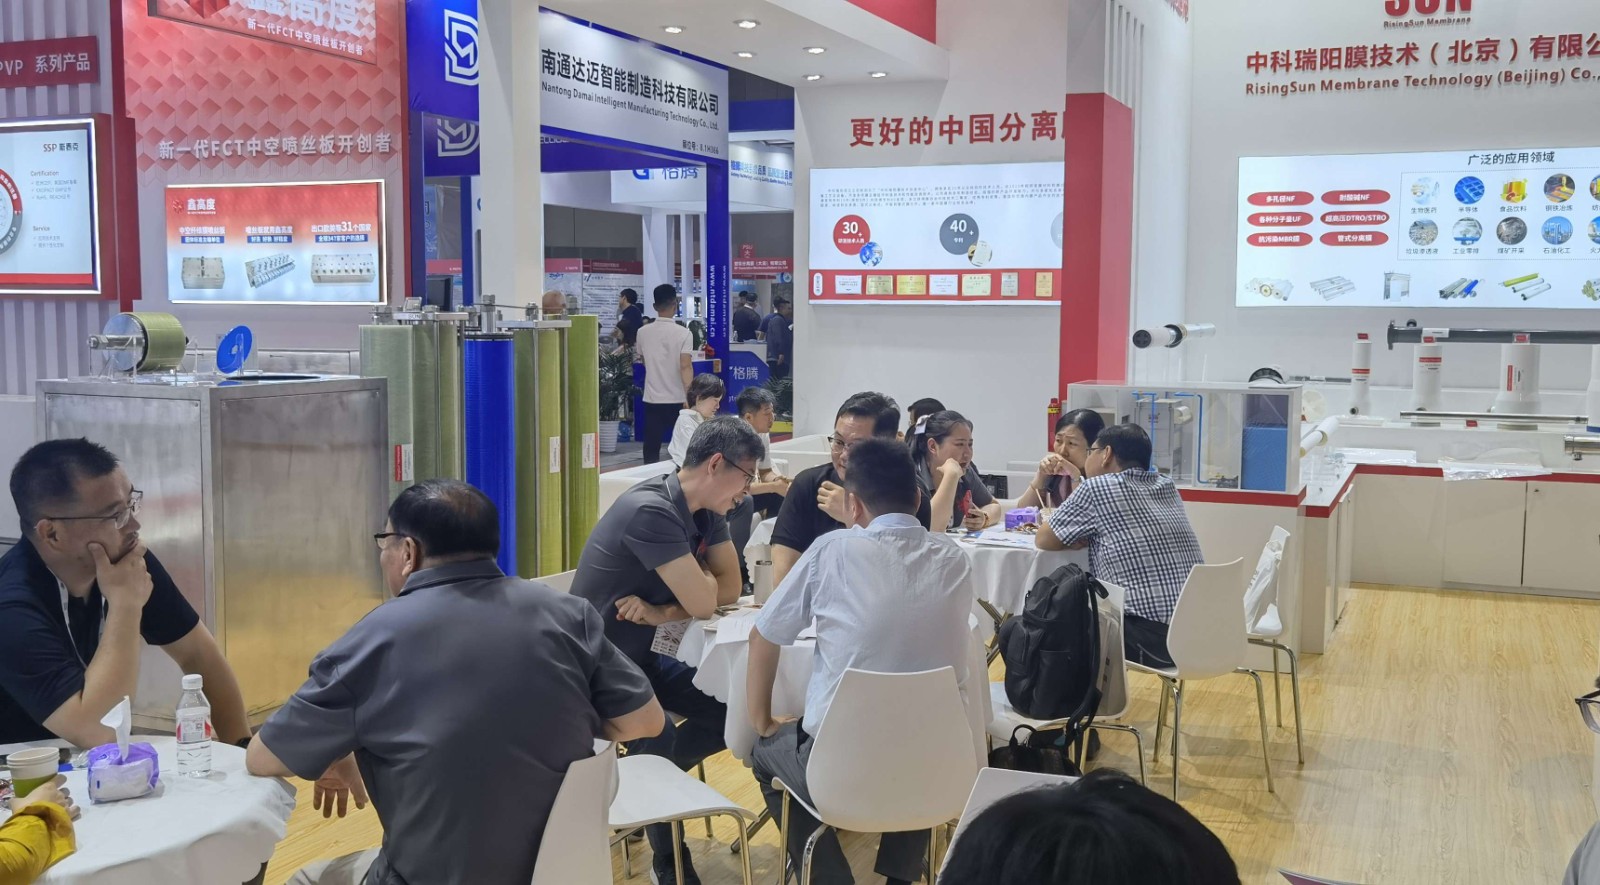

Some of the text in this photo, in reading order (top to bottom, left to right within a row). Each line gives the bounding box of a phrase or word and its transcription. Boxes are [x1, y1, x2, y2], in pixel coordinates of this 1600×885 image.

[1383, 17, 1471, 29] RisingSun Membrane
[35, 52, 91, 74] 系列产品
[541, 48, 719, 116] 南通达迈智能制造科技有限公司
[1245, 81, 1316, 97] RisingSun
[1320, 77, 1399, 92] Membrane
[1403, 73, 1493, 88] Technology
[1497, 68, 1566, 85] (Beijing)
[541, 81, 572, 100] Nantong
[573, 88, 594, 102] Damai
[594, 93, 627, 110] Intelligent
[627, 100, 669, 121] Manufacturing
[669, 110, 699, 127] Technology
[849, 110, 1066, 147] 更好的中国分离
[43, 143, 58, 153] SSP
[159, 131, 393, 161] 新一代FCT中空喷丝板开创者
[1467, 151, 1556, 166] 广泛的应用领域
